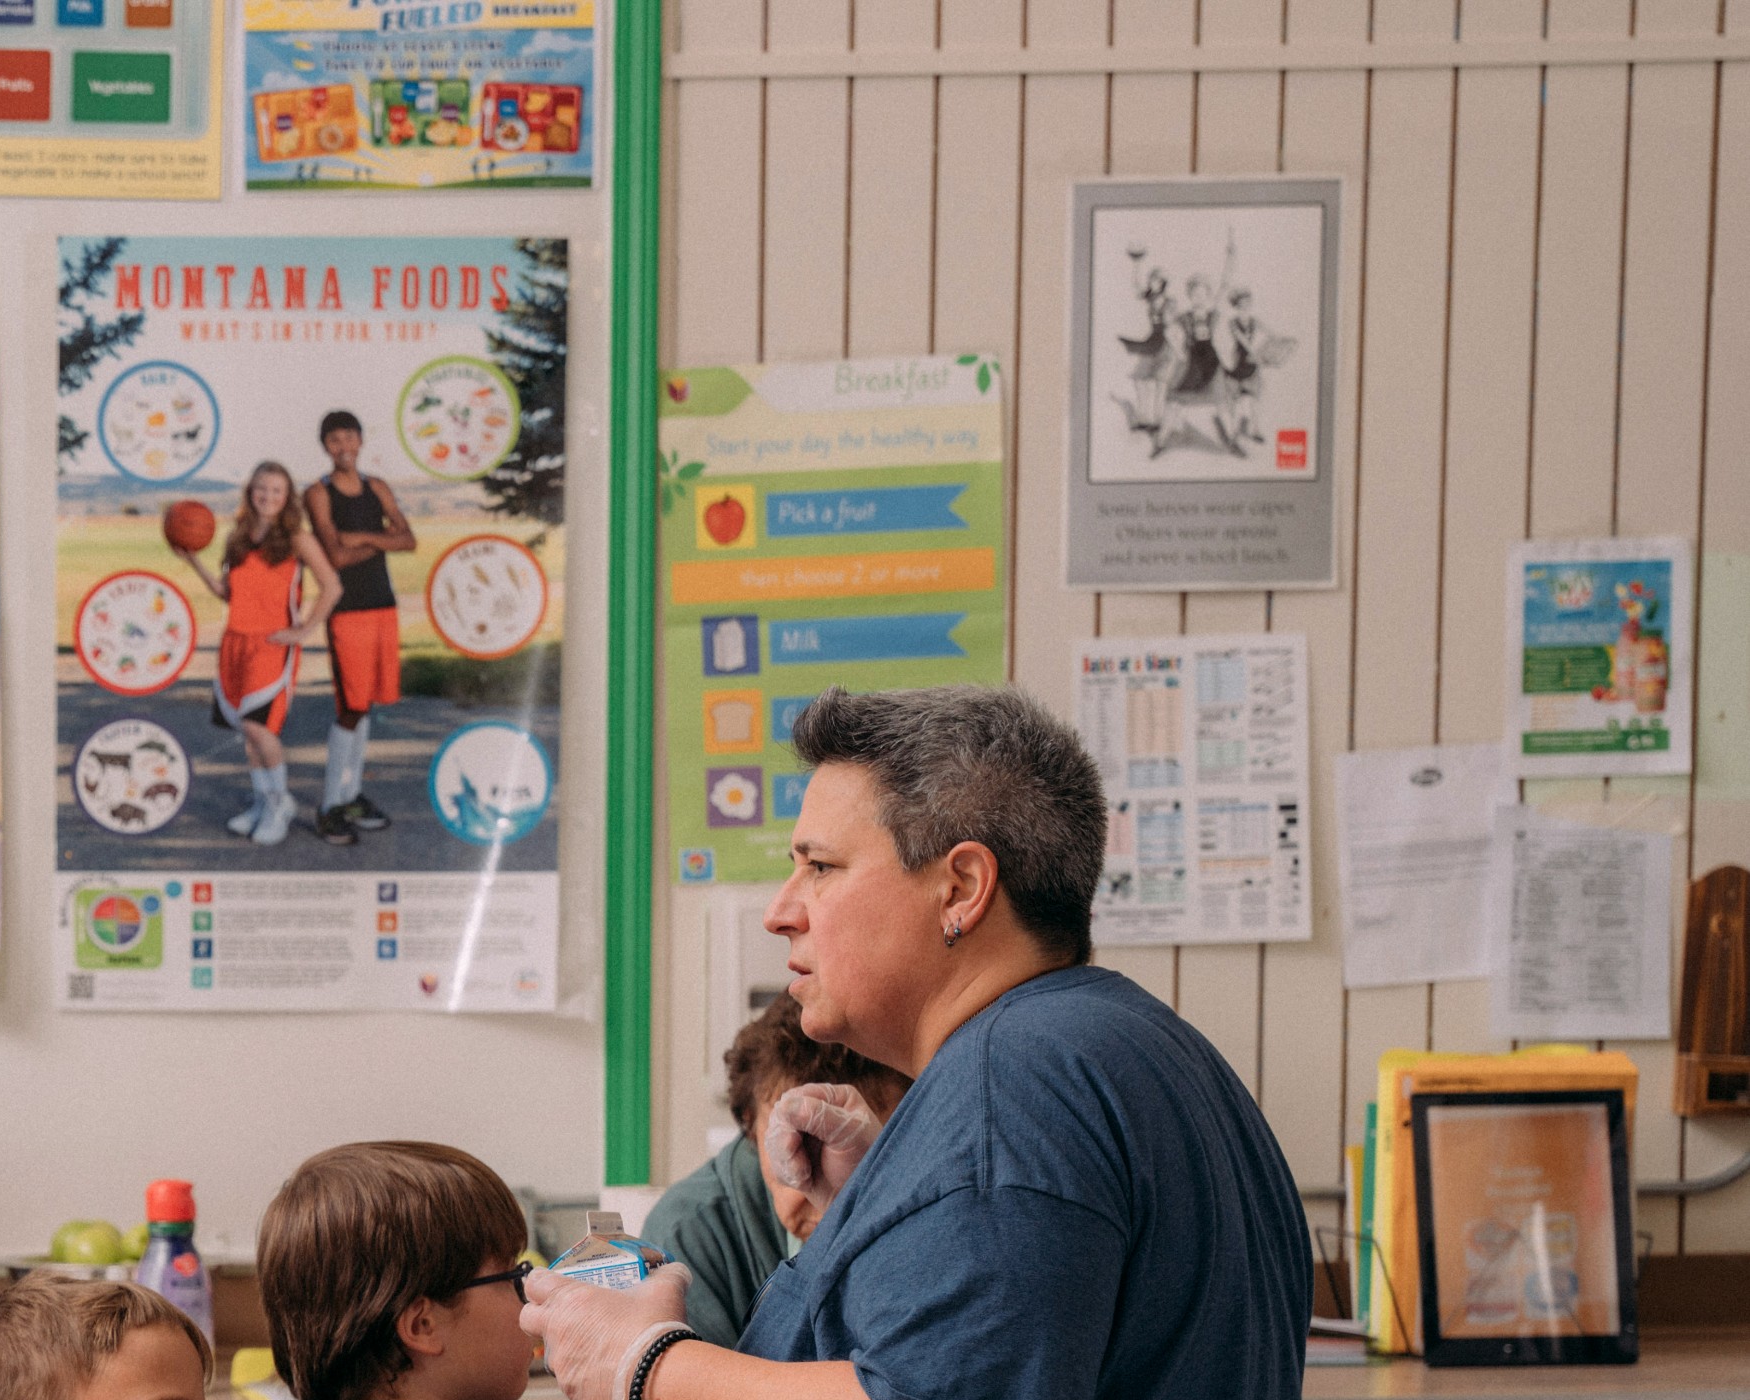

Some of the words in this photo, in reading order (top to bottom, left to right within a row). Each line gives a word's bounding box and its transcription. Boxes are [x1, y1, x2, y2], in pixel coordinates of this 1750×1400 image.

[381, 1, 483, 33] FUELED
[87, 80, 155, 97] Vegetables
[114, 264, 344, 312] MONTANA
[372, 265, 512, 313] FOODS
[833, 362, 950, 400] Breakfast
[777, 500, 817, 524] Pick
[821, 507, 833, 524] a
[835, 497, 877, 530] fruit
[781, 627, 821, 653] Milk
